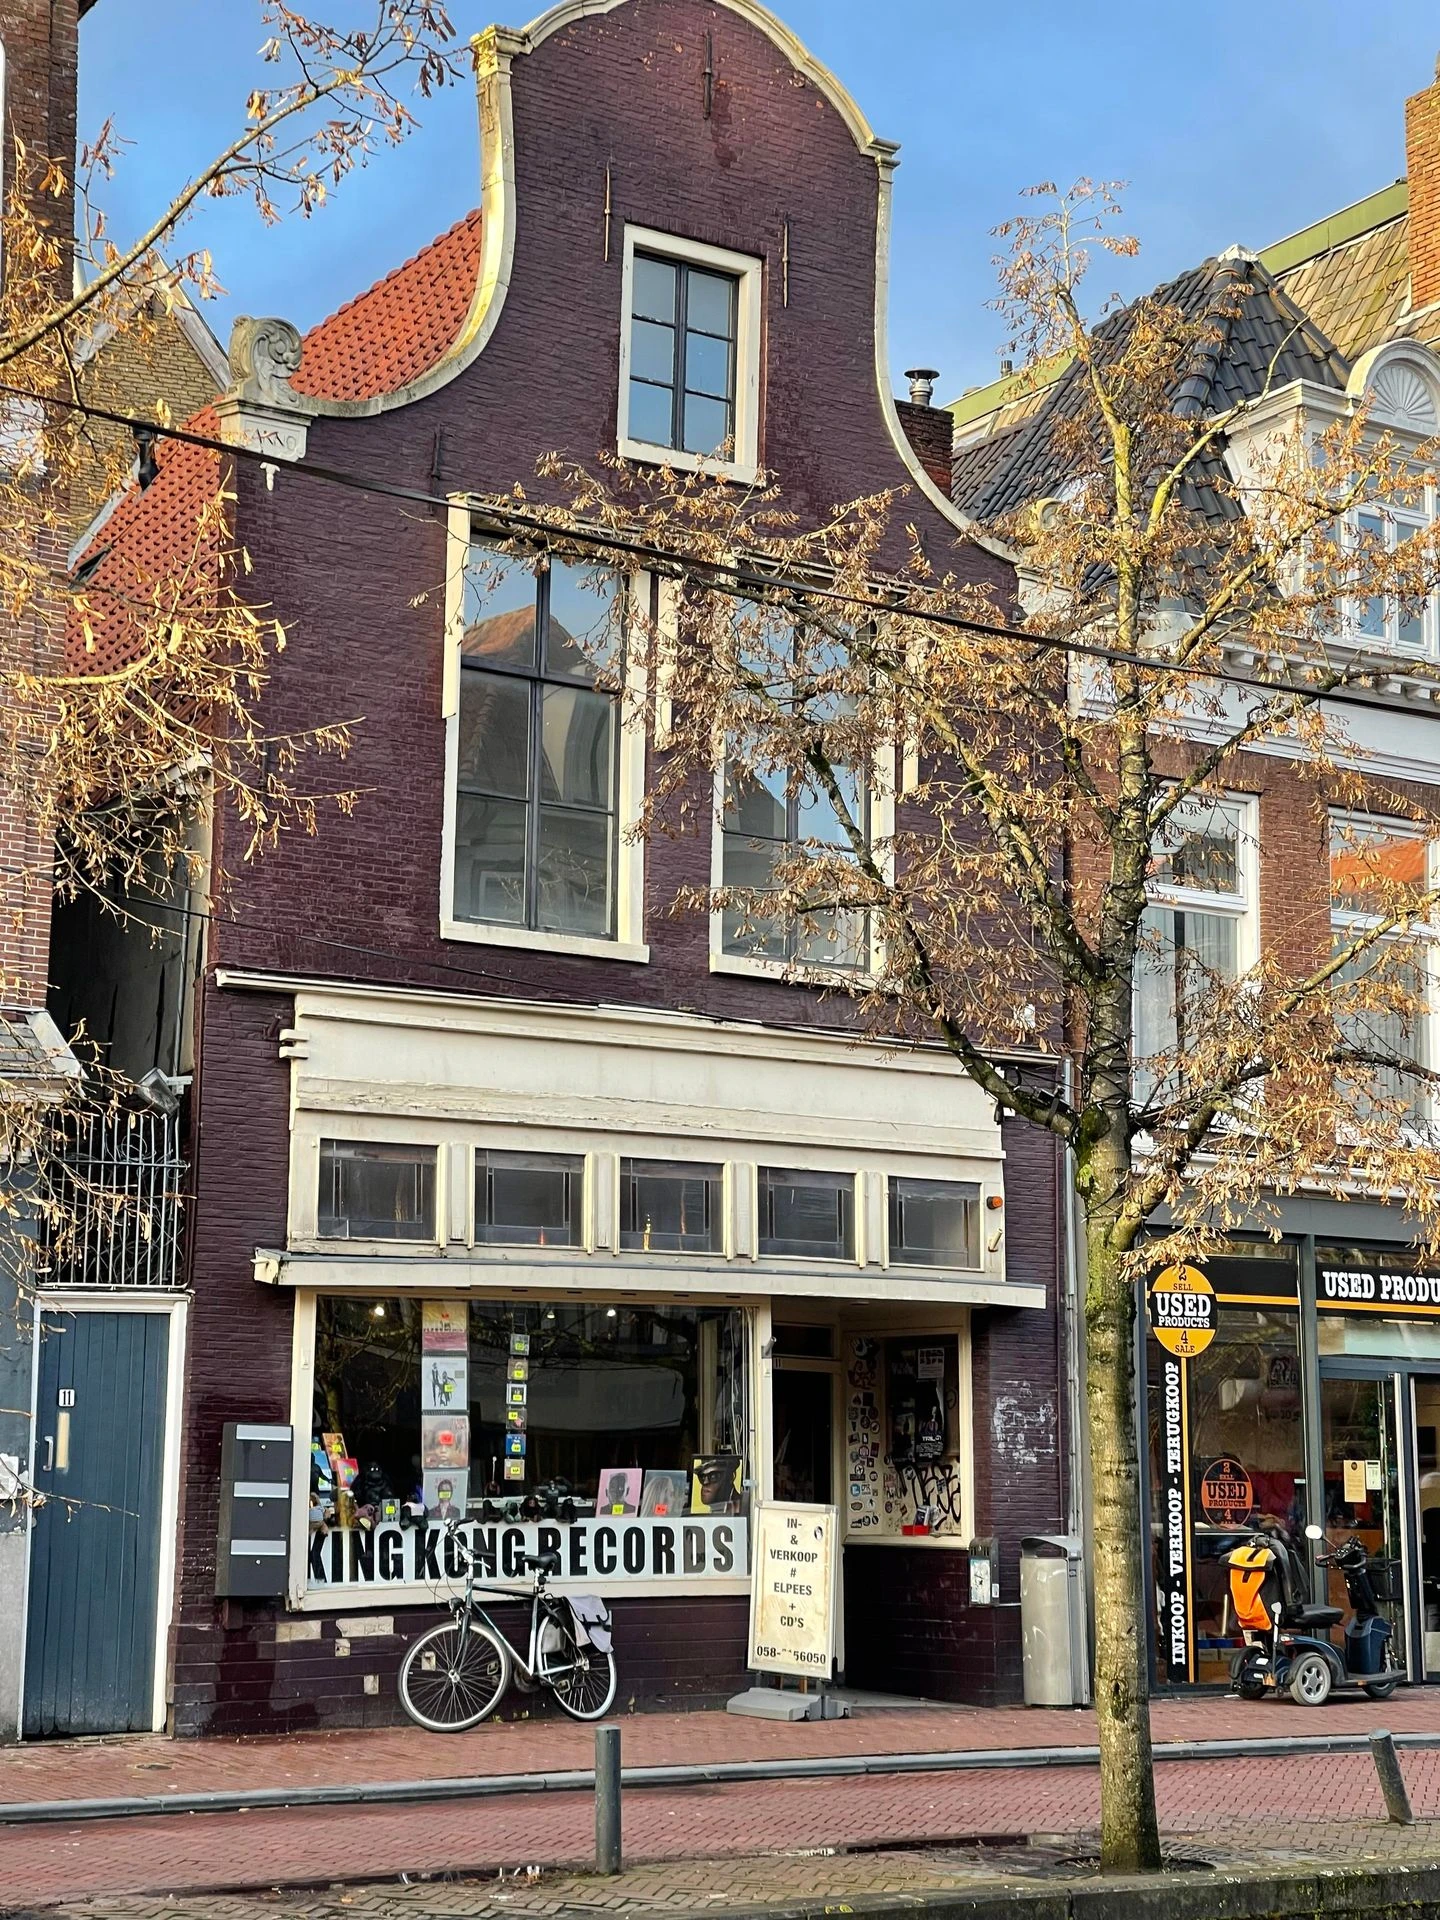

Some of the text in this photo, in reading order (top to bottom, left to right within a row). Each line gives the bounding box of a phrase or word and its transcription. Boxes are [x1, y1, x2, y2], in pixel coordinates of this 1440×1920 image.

[1173, 1283, 1193, 1291] SELL
[1322, 1271, 1440, 1303] USED PRODU
[1155, 1292, 1211, 1317] USED
[1158, 1316, 1210, 1328] PRODUCTS
[1181, 1330, 1188, 1344] 4
[1175, 1345, 1195, 1353] SALE
[62, 1390, 71, 1405] 11
[1165, 1362, 1181, 1473] TERUGKOOP
[1206, 1482, 1247, 1499] USED
[1209, 1499, 1247, 1507] PRODUCTS
[1224, 1509, 1231, 1520] 4
[787, 1518, 803, 1529] IN-
[1168, 1488, 1184, 1576] VERKOOP
[790, 1535, 799, 1545] &
[308, 1525, 734, 1583] KING KONG RECORDS
[770, 1549, 818, 1563] VERKOOP
[774, 1582, 812, 1596] ELPEES
[780, 1615, 804, 1628] CD'S
[1170, 1591, 1186, 1665] INKOOP
[756, 1645, 826, 1664] 058-56050
